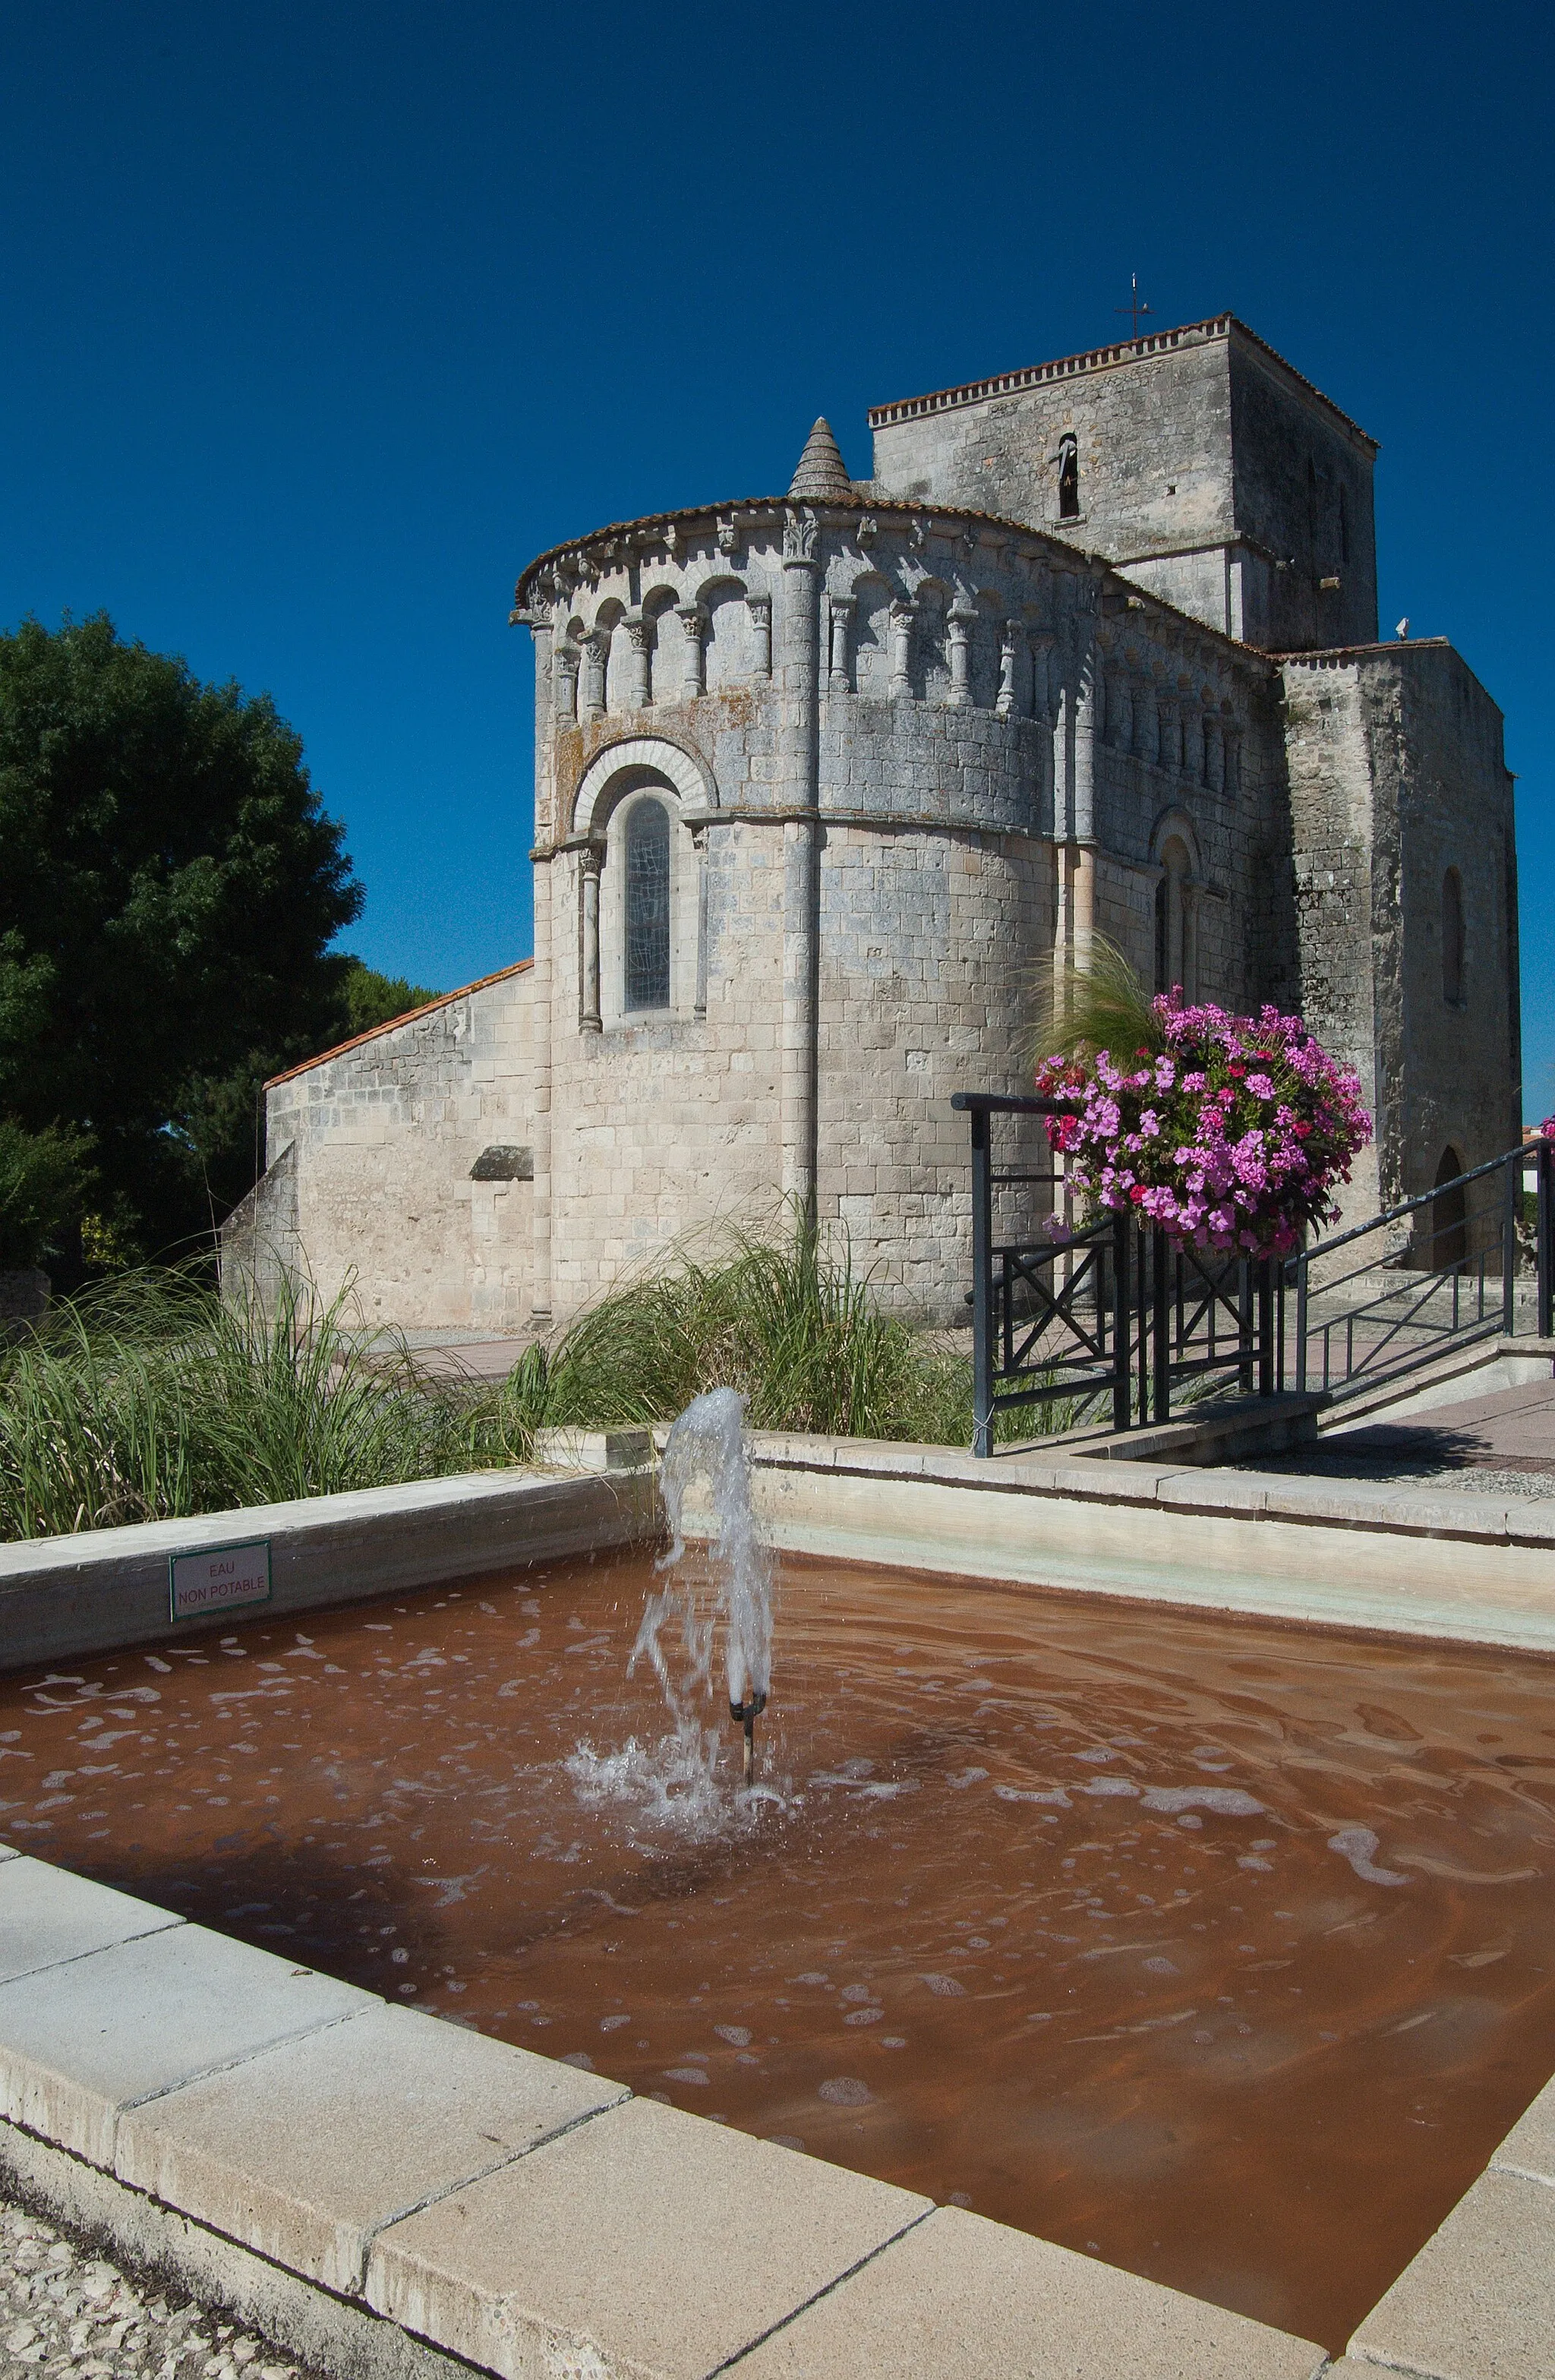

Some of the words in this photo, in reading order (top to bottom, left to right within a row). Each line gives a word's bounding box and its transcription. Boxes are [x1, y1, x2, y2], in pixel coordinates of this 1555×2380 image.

[210, 1561, 235, 1577] EAU
[178, 1588, 207, 1605] NON
[210, 1576, 265, 1598] POTABLE
